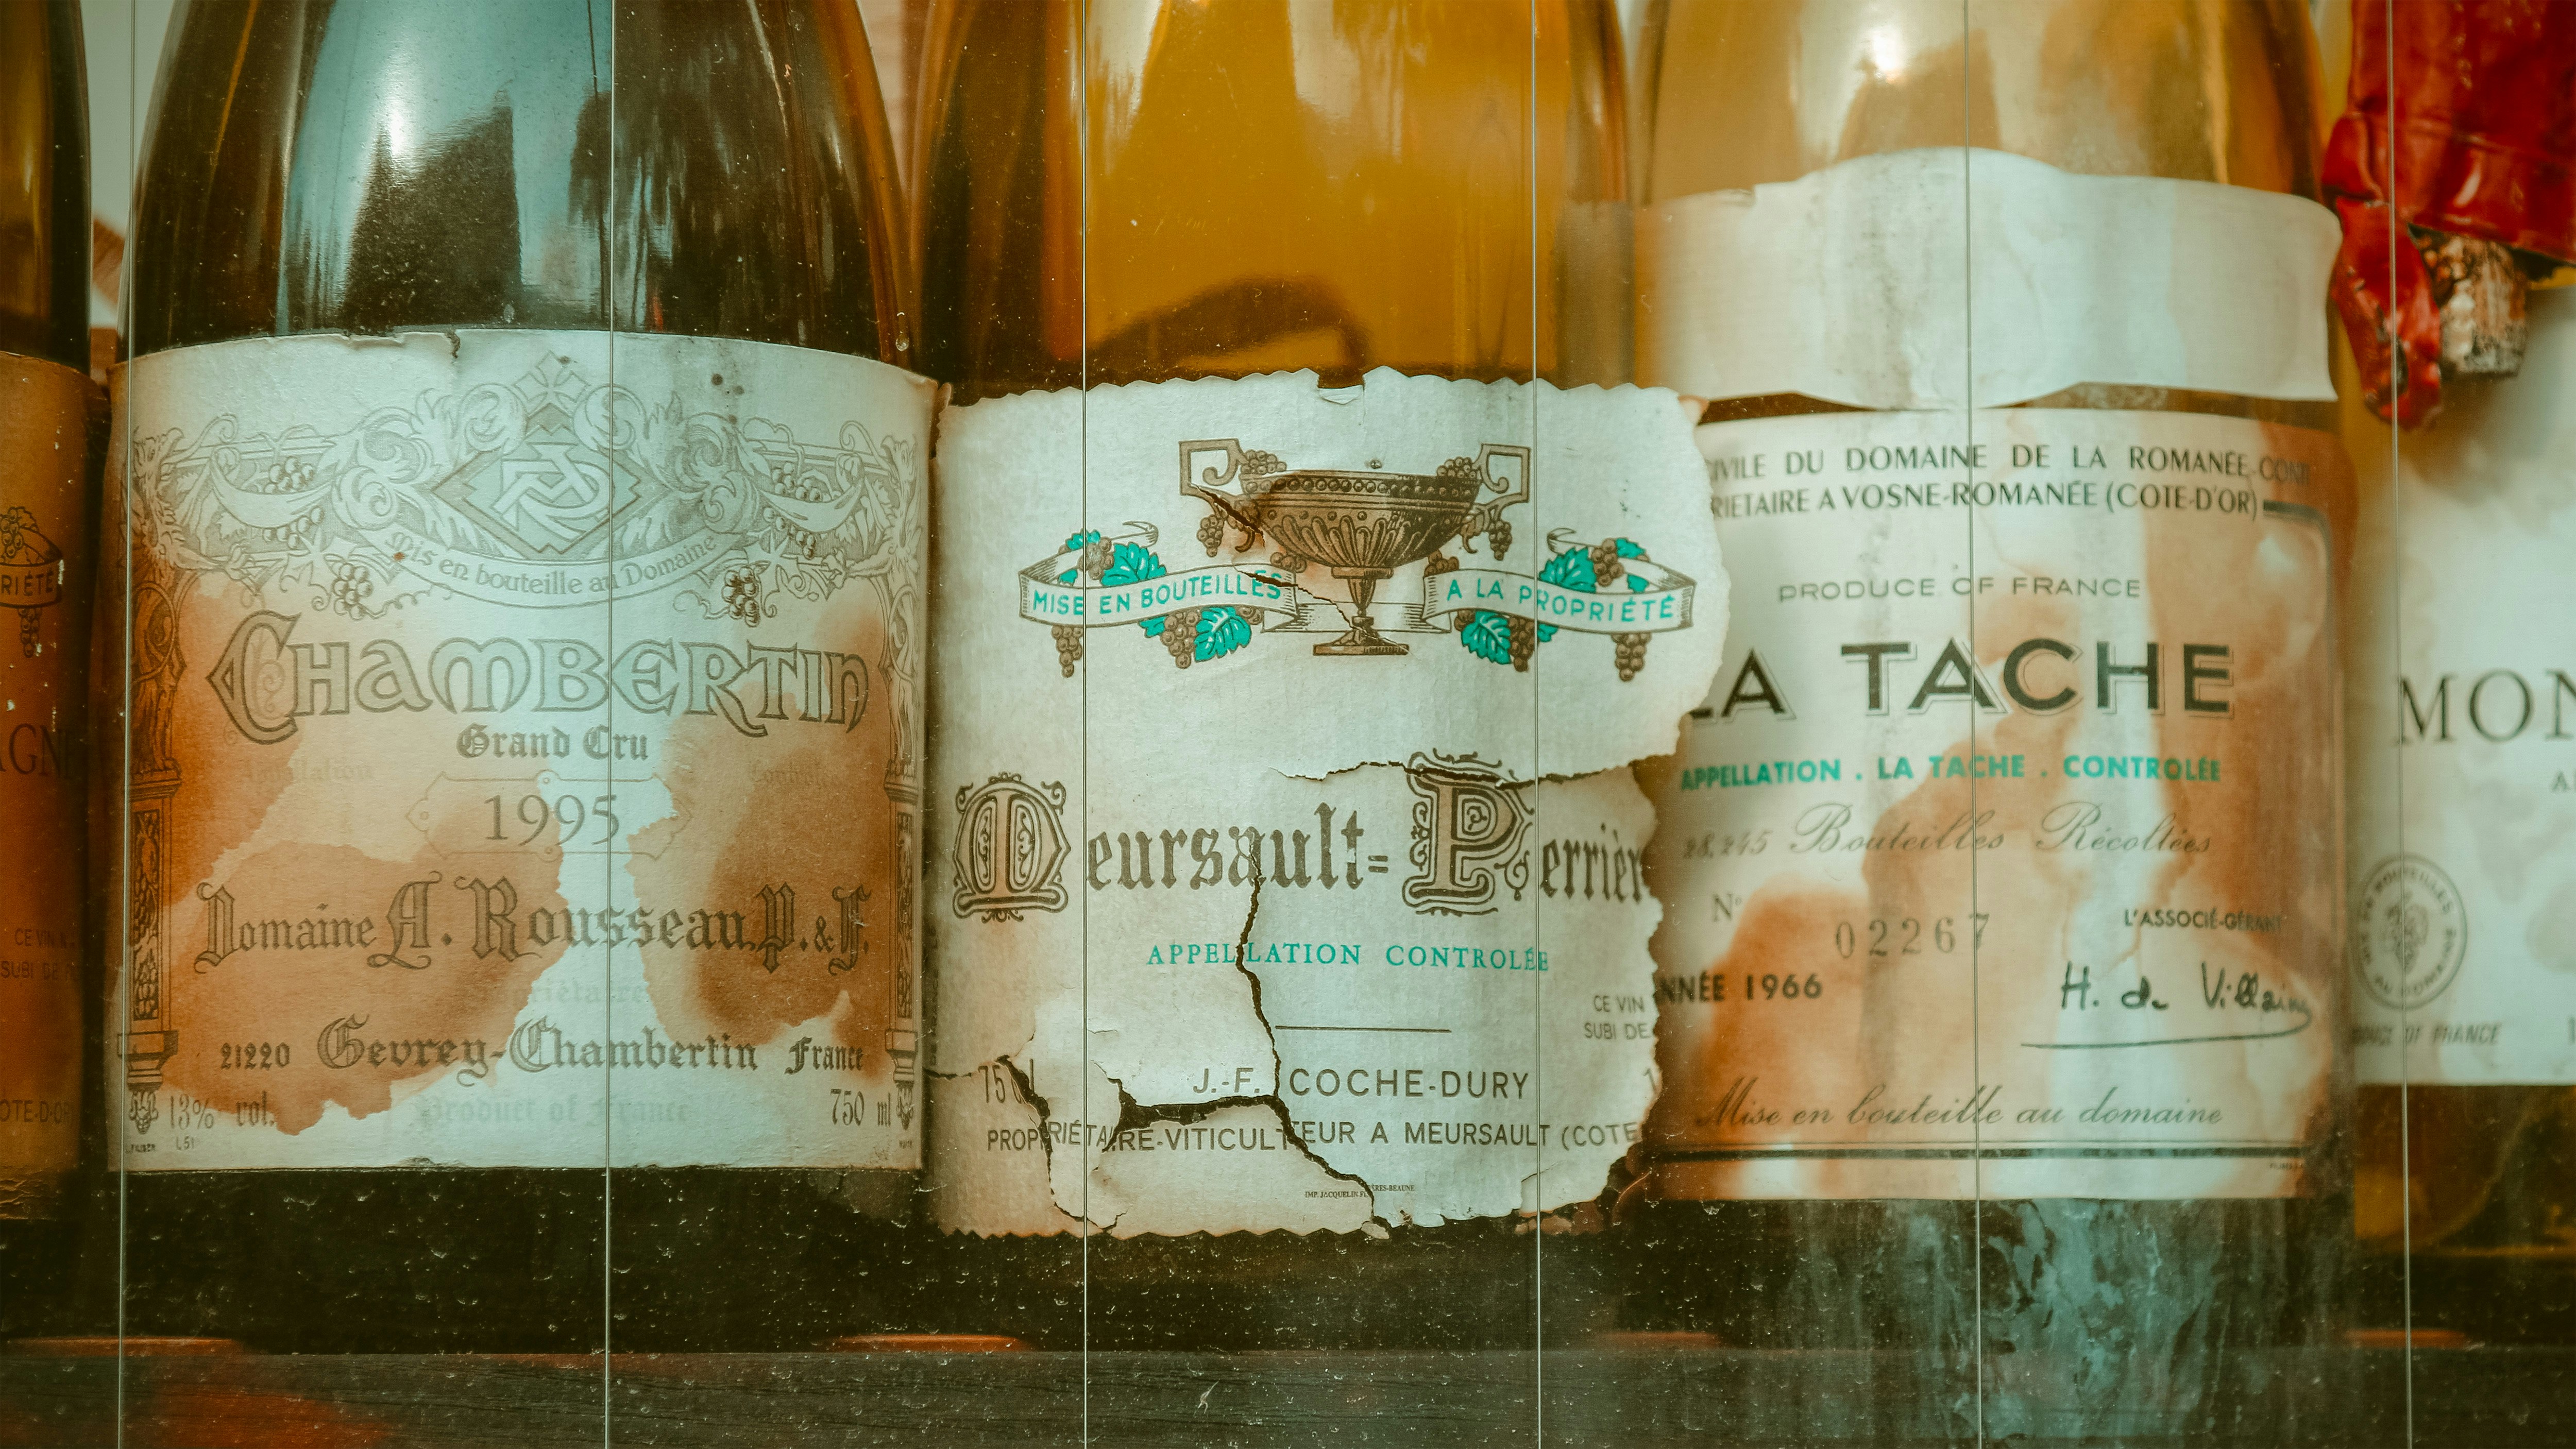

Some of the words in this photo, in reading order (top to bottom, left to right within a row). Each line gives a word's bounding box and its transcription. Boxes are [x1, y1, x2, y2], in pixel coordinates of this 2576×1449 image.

[1786, 449, 1824, 475] DU
[1846, 445, 1987, 471] DOMAINE
[2012, 444, 2050, 468] DE
[2073, 445, 2107, 469] LA
[1819, 487, 1837, 510] A
[438, 555, 469, 581] en
[474, 568, 582, 595] bouteille
[588, 573, 619, 594] au
[622, 534, 717, 588] Domaine
[1033, 589, 1083, 615] MISE
[1099, 591, 1131, 615] EN
[1141, 570, 1282, 608] BOUTEILLES
[1446, 578, 1463, 601] A
[1476, 578, 1504, 600] LA
[1518, 584, 1676, 622] PROPRIÉTÉ
[1778, 578, 1936, 602] PRODUCE
[1952, 576, 1994, 595] OF
[2012, 576, 2141, 598] FRANCE
[1840, 637, 2234, 720] TACHE
[455, 722, 570, 759] Grand
[582, 724, 649, 762] Cru
[1681, 758, 1841, 791] APPELLATION
[1878, 756, 1914, 780] LA
[1928, 755, 2025, 779] TACHE
[2063, 754, 2222, 782] CONTROLÉE
[484, 794, 619, 846] 1995
[1789, 802, 2005, 854] Bouteilles
[2035, 800, 2210, 853] Récoltées
[193, 881, 377, 974] Domaine
[1835, 912, 1991, 959] 02267
[1146, 942, 1360, 966] APPELLATION
[1386, 945, 1549, 972] CONTROLÉE
[1594, 995, 1610, 1013] CE
[1617, 996, 1645, 1014] VIN
[1745, 973, 1823, 1000] 1966
[220, 1042, 291, 1069] 21220
[317, 1013, 759, 1086] Gevrey-Chambertin
[784, 1036, 863, 1075] France
[1584, 1022, 1616, 1040] SUBI
[1624, 1022, 1651, 1041] DE
[1289, 1067, 1530, 1099] COCHE-DURY
[1694, 1076, 1782, 1127] Mise
[1792, 1109, 1834, 1125] en
[1846, 1082, 2004, 1125] bouteille
[2015, 1109, 2064, 1125] au
[2078, 1086, 2224, 1126] domaine
[170, 1093, 215, 1130] 13%
[830, 1088, 865, 1127] 750
[876, 1099, 891, 1127] ml
[1370, 1121, 1389, 1145] A
[1405, 1121, 1550, 1147] MEURSAULT
